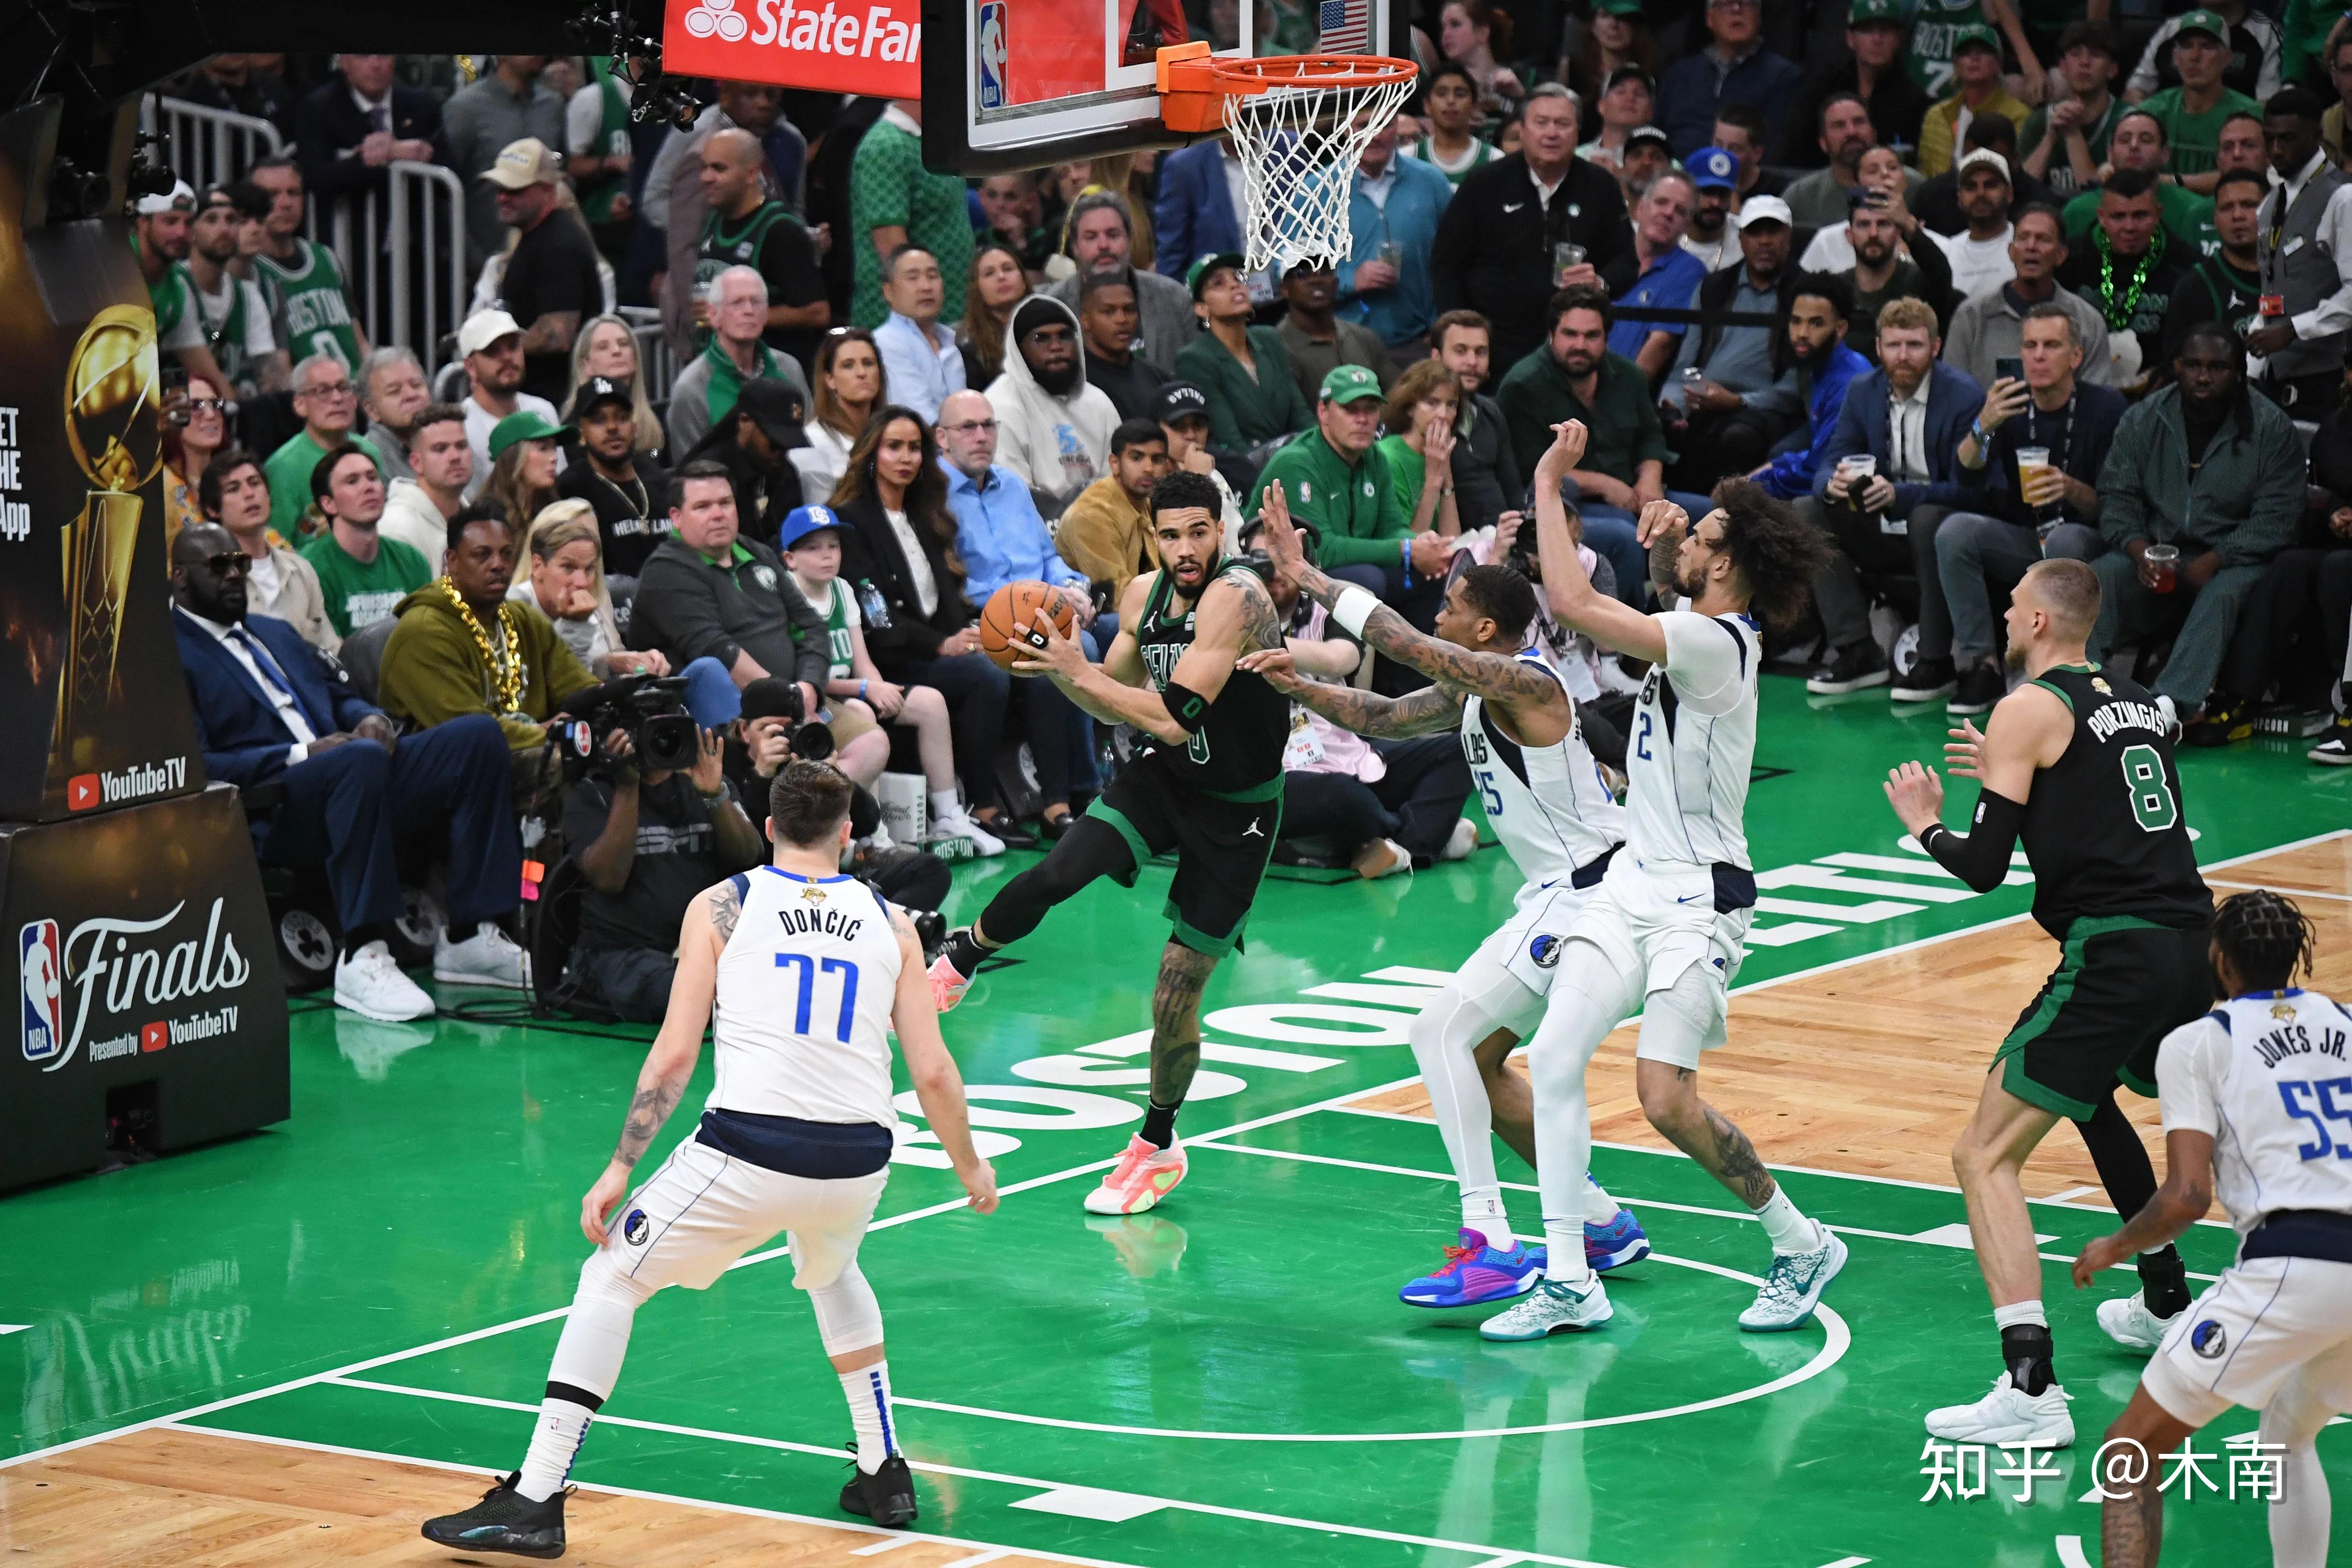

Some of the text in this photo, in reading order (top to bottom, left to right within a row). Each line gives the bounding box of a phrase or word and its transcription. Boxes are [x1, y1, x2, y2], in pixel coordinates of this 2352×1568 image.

[984, 86, 997, 103] NBA
[1924, 62, 1953, 98] 7
[1031, 634, 1044, 645] 0
[1182, 697, 1203, 719] 0
[2087, 700, 2165, 744] PORZINGIS
[1637, 711, 1652, 761] 2
[2120, 744, 2177, 832] 8
[778, 908, 864, 942] DONČIĆ
[42, 897, 250, 1072] Finals
[774, 952, 859, 1044] 77
[28, 1026, 47, 1051] NBA
[89, 1033, 127, 1063] Presented
[128, 1032, 138, 1057] by
[2253, 1025, 2346, 1069] JONES JR.
[2277, 1077, 2352, 1161] 55
